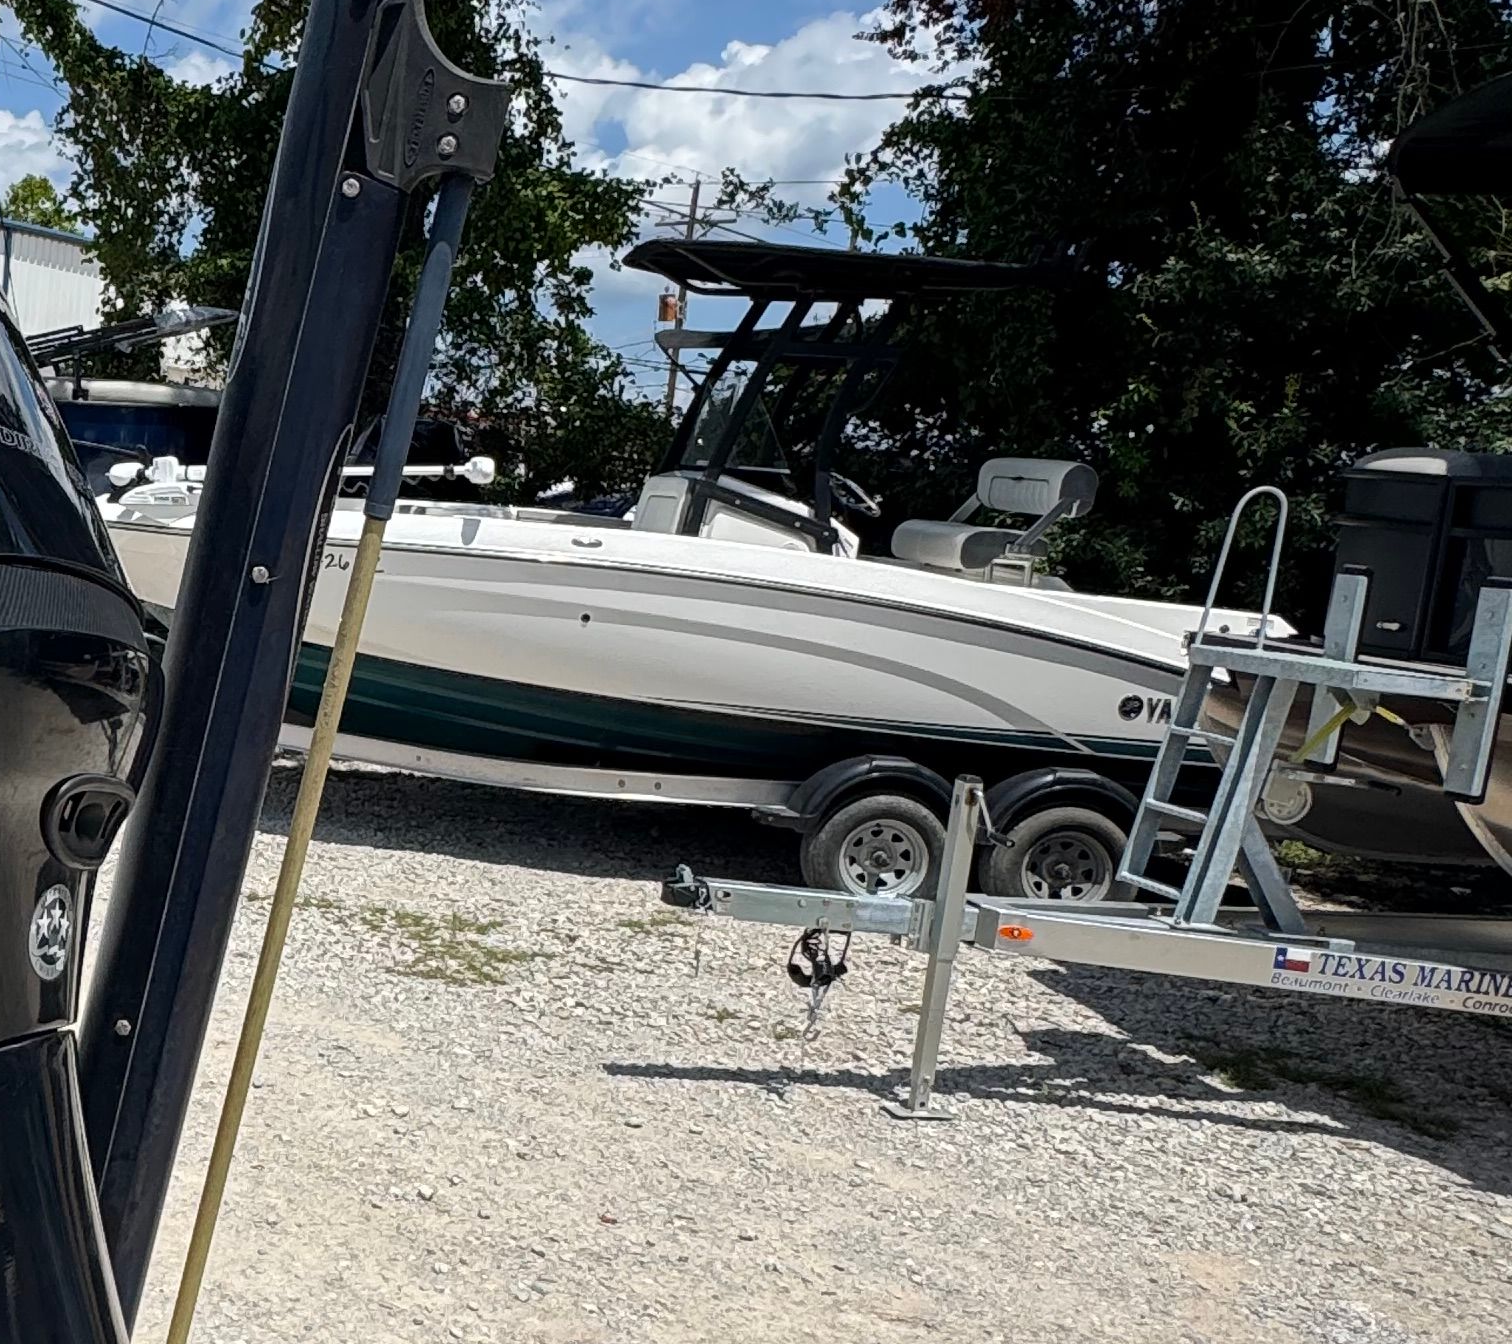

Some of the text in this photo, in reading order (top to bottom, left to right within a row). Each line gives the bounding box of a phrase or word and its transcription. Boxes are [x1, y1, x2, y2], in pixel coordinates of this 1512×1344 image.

[1317, 953, 1407, 985] TEXAS
[1271, 972, 1349, 993] Beaumont
[1370, 984, 1440, 1005] Clearlake
